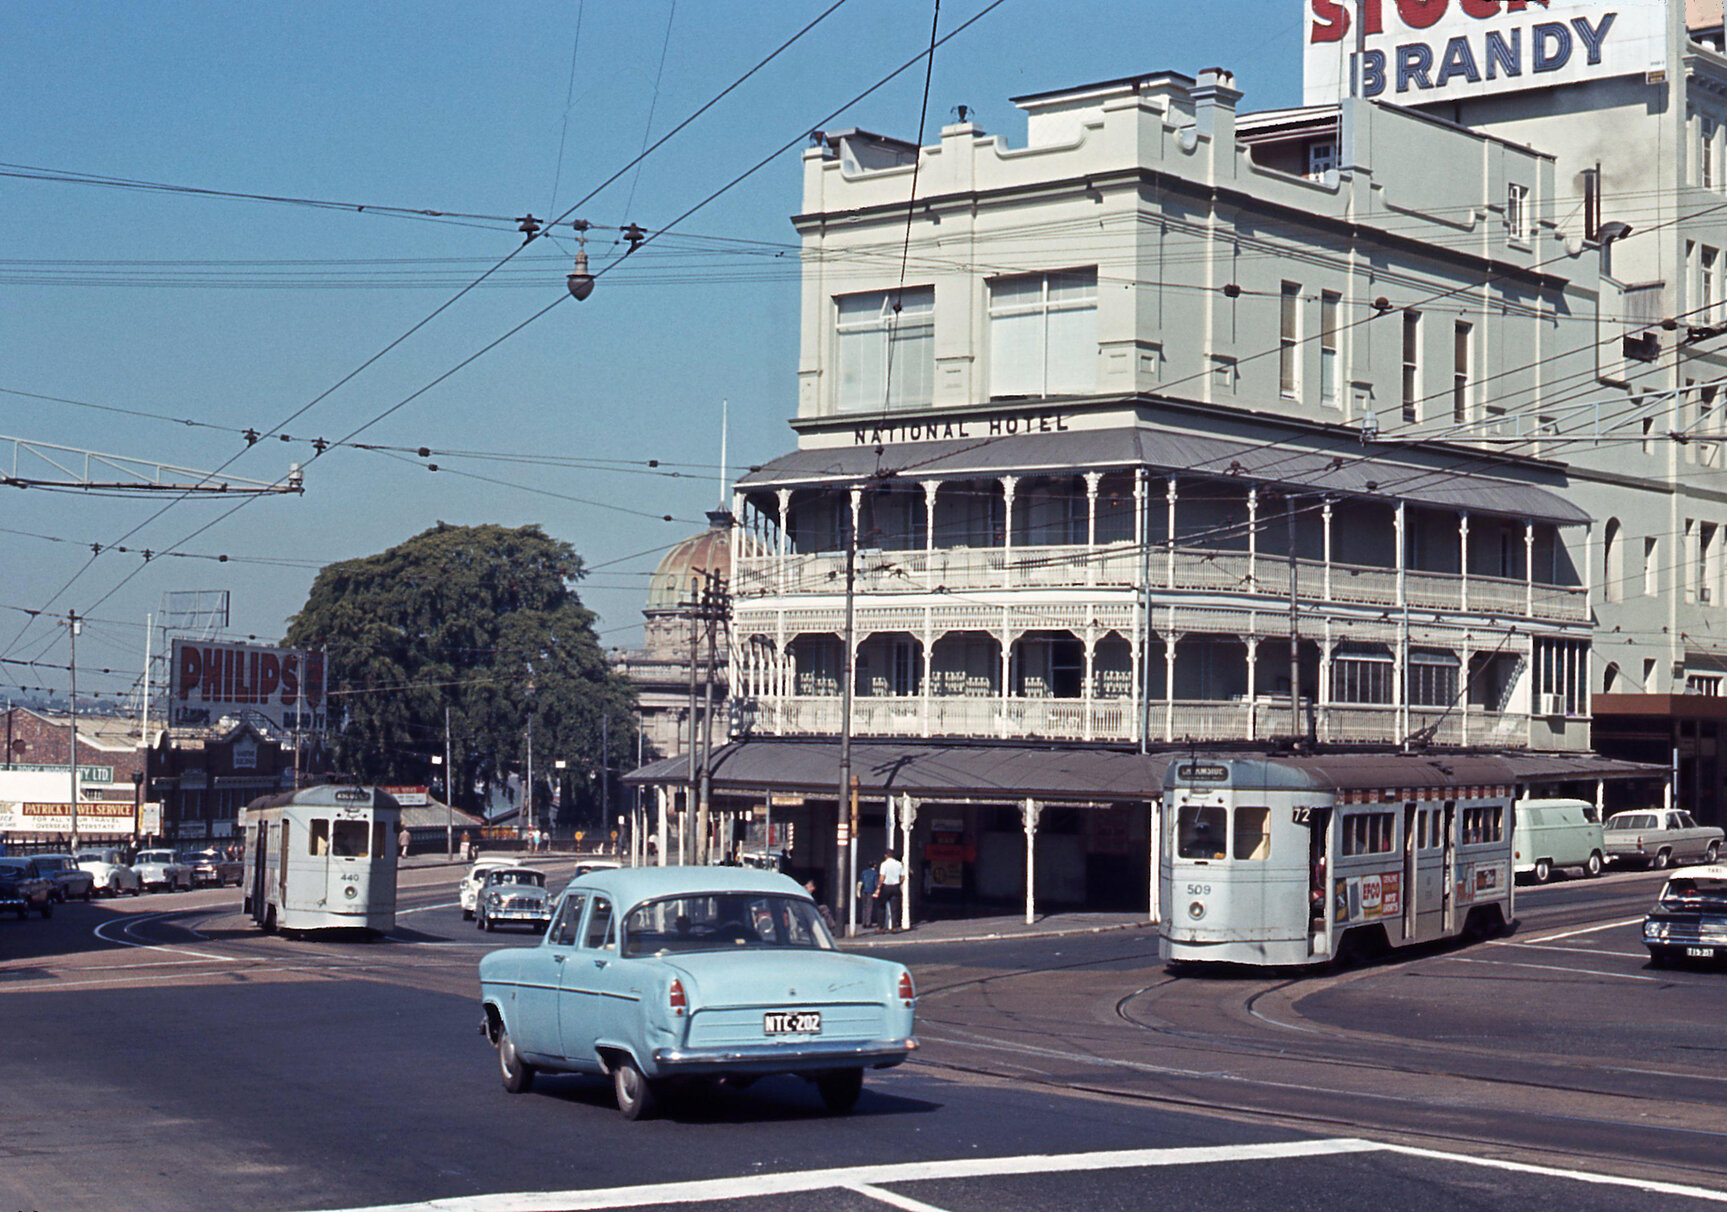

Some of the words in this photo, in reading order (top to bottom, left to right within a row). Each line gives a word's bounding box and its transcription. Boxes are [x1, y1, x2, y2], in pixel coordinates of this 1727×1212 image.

[1350, 13, 1617, 97] BRANDY
[854, 422, 969, 445] NATIONAL
[989, 414, 1069, 436] HOTEL
[179, 646, 299, 706] PHILIPS
[25, 803, 62, 815] PATRICK
[96, 804, 131, 816] SERVICE
[1294, 808, 1310, 822] 72
[1187, 884, 1211, 895] 509
[1362, 882, 1380, 900] EFCO
